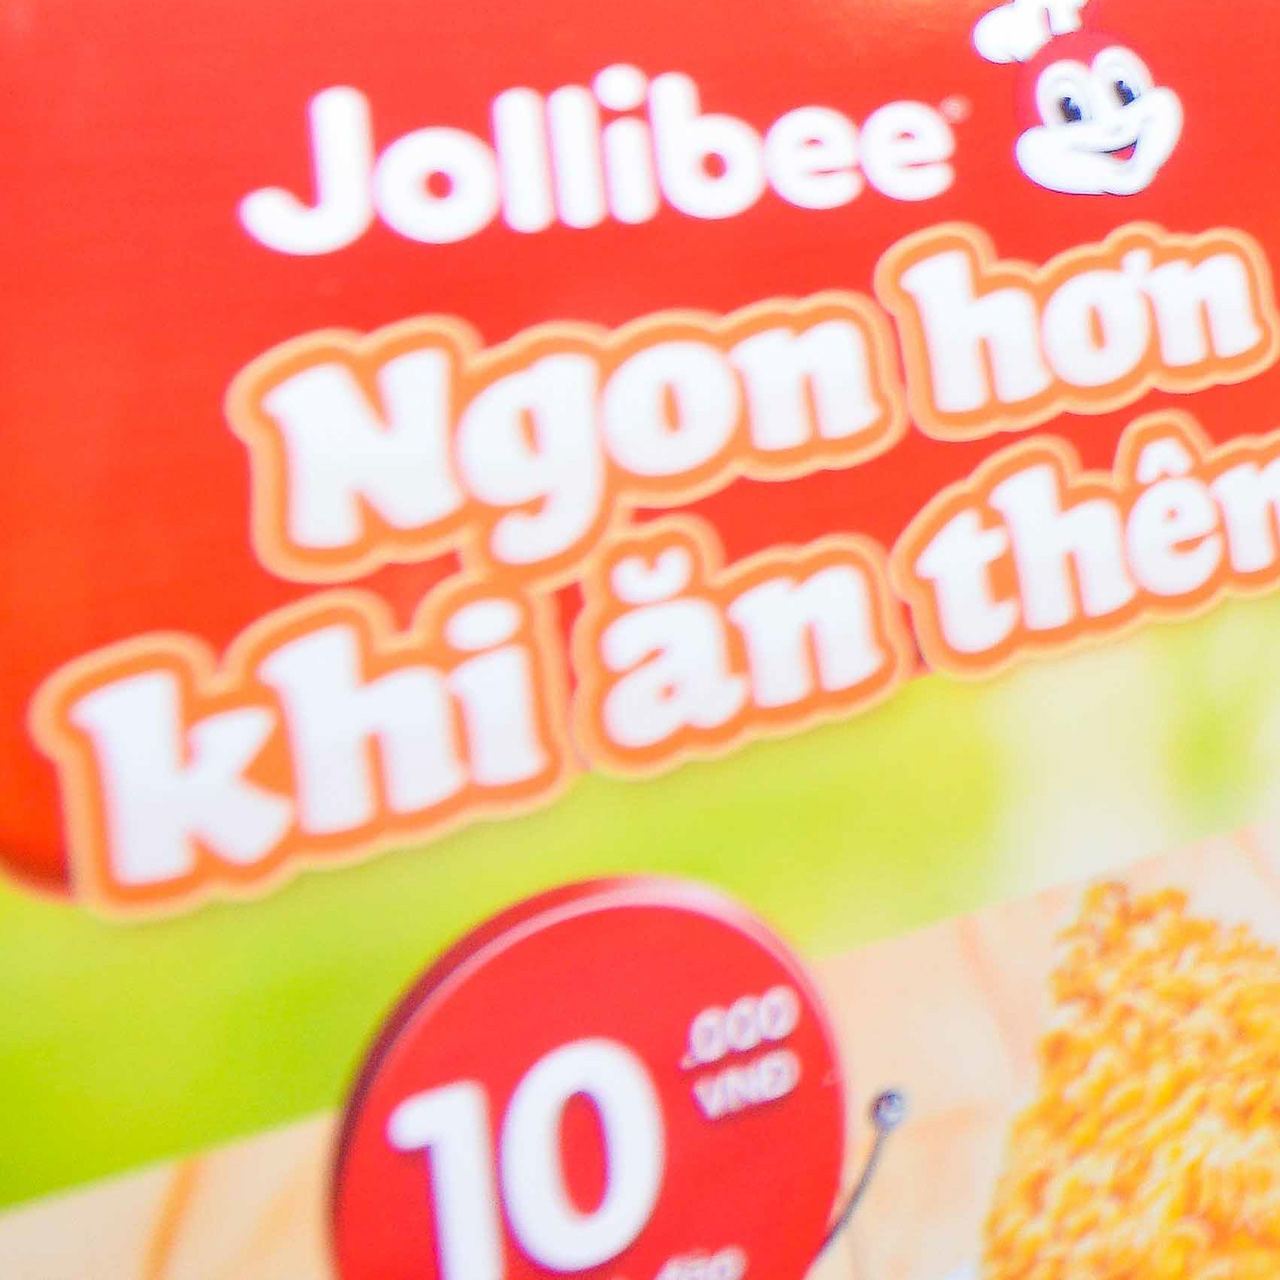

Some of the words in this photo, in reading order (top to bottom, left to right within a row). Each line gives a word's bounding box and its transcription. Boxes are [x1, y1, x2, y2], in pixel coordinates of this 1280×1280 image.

[237, 62, 956, 257] Jollibee
[260, 318, 886, 568] Ngon
[899, 247, 1263, 415] hơn
[72, 596, 547, 889] khi
[602, 552, 887, 753] ăn
[386, 1036, 668, 1280] 10
